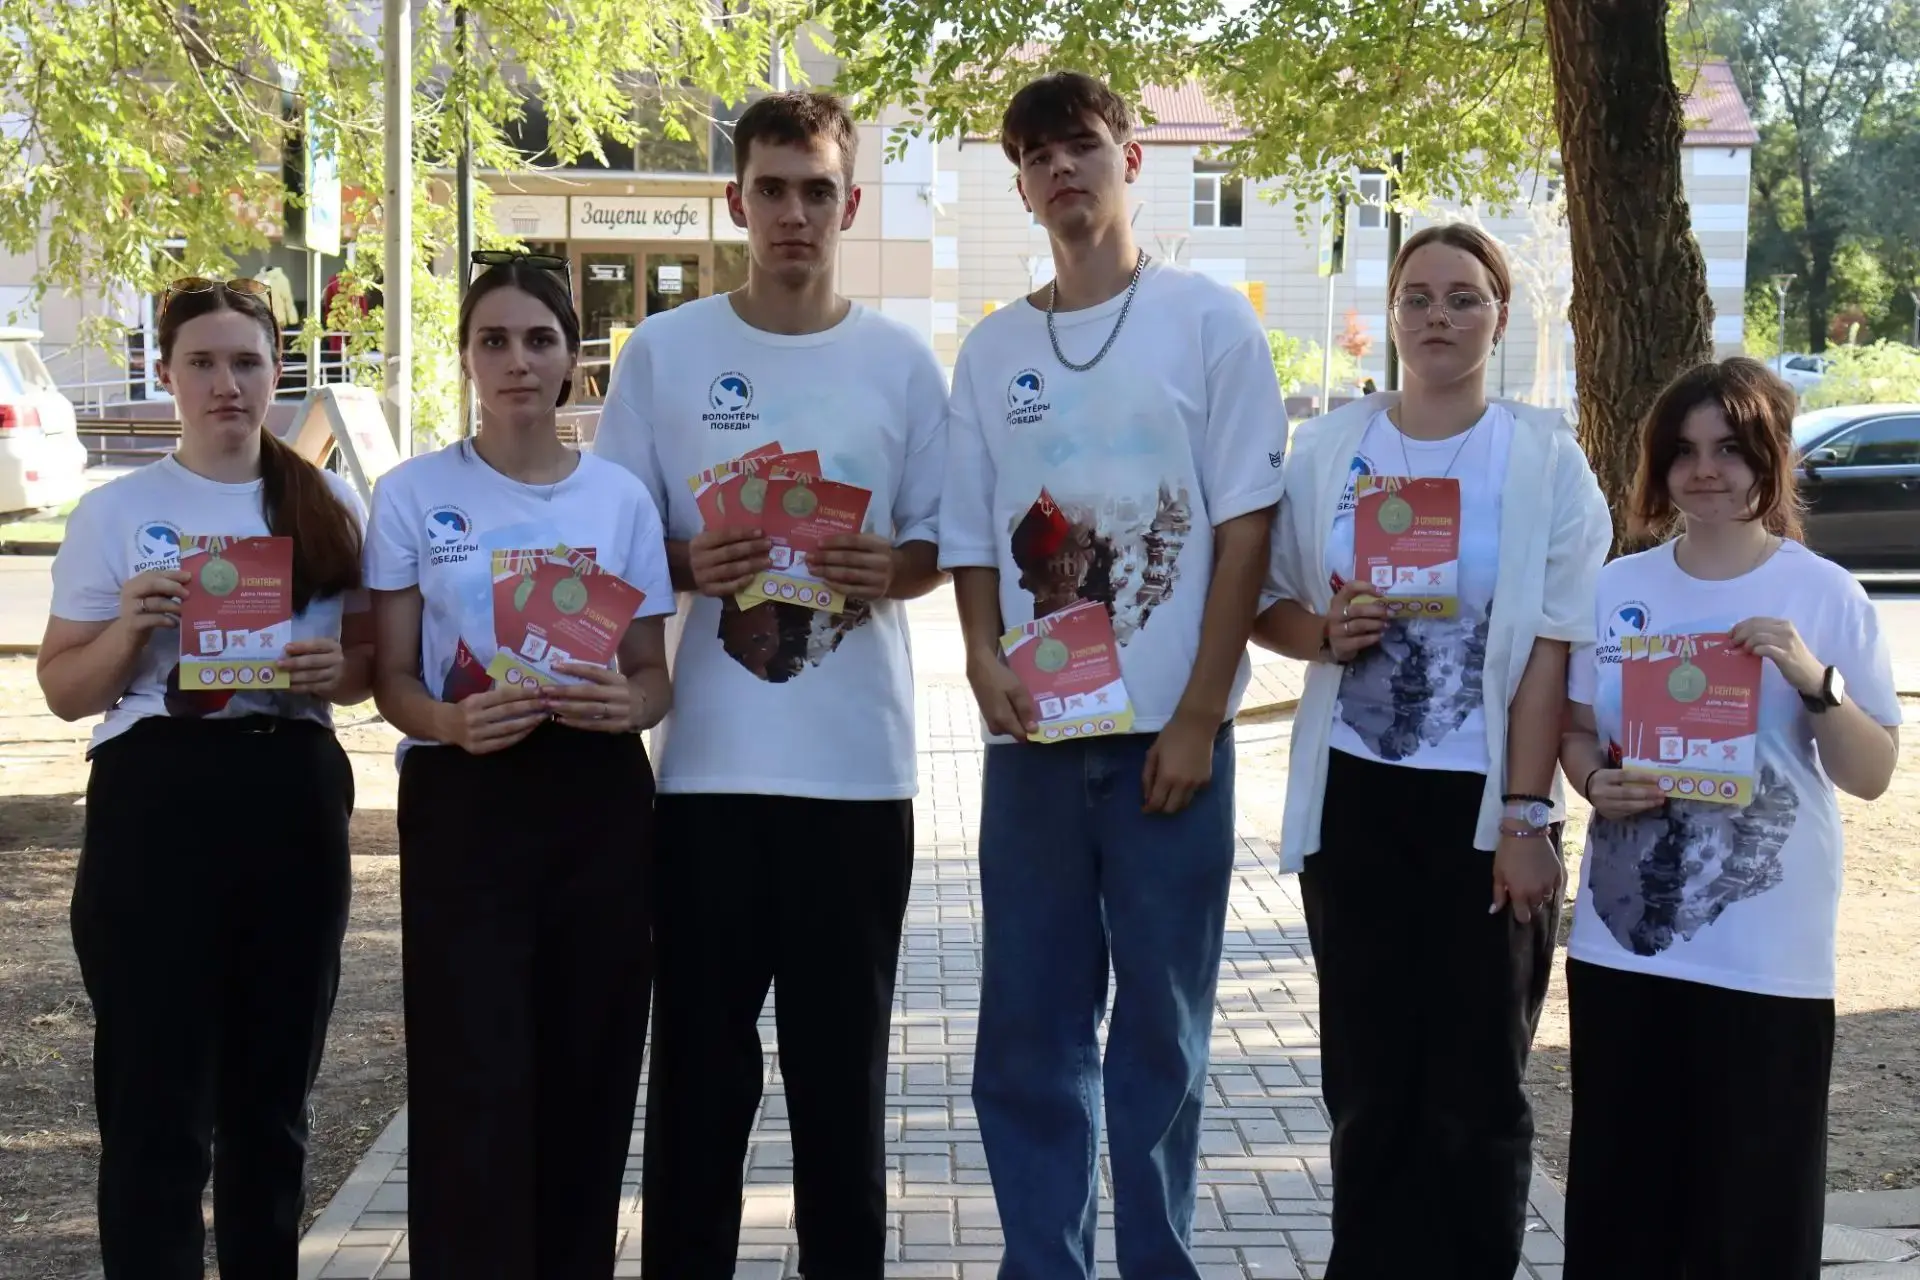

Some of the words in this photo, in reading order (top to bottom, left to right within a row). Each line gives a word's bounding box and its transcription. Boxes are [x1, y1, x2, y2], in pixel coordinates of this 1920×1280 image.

[581, 202, 647, 230] Зацепи
[653, 203, 698, 235] кофе
[702, 412, 760, 421] ВОЛОНТЁРЫ
[710, 422, 750, 430] ПОБЕДЫ
